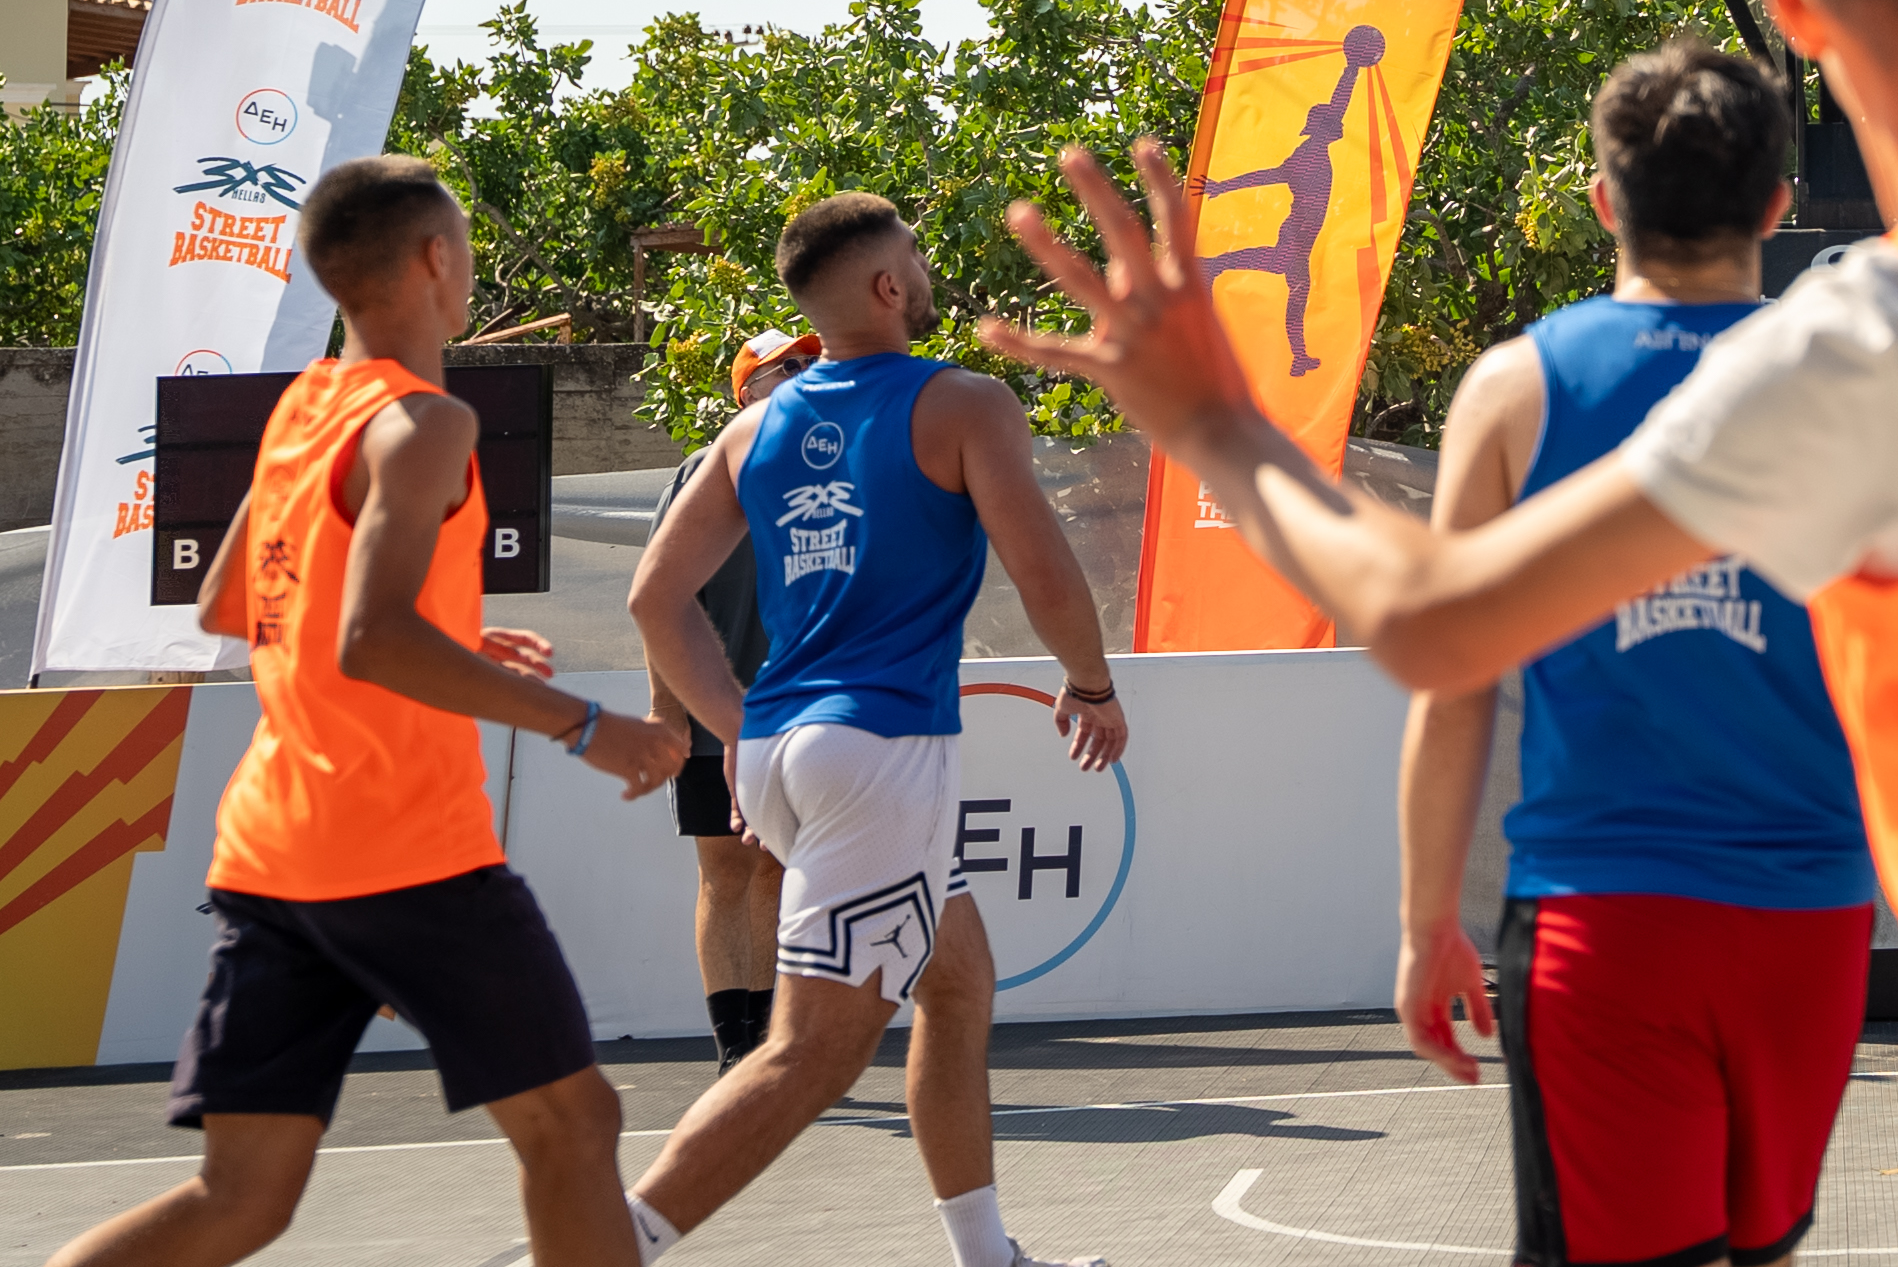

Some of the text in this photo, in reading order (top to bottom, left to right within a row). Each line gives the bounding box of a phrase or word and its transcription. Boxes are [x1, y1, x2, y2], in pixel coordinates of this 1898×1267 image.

[243, 101, 287, 132] ΔΕΗ
[191, 201, 287, 244] STREET
[169, 231, 292, 284] BASKETBALL
[807, 436, 838, 454] ΔΕΗ
[1197, 501, 1230, 520] TH
[494, 528, 520, 558] B
[790, 518, 847, 553] STREET
[172, 539, 200, 570] B
[954, 798, 1082, 900] ΕΗ
